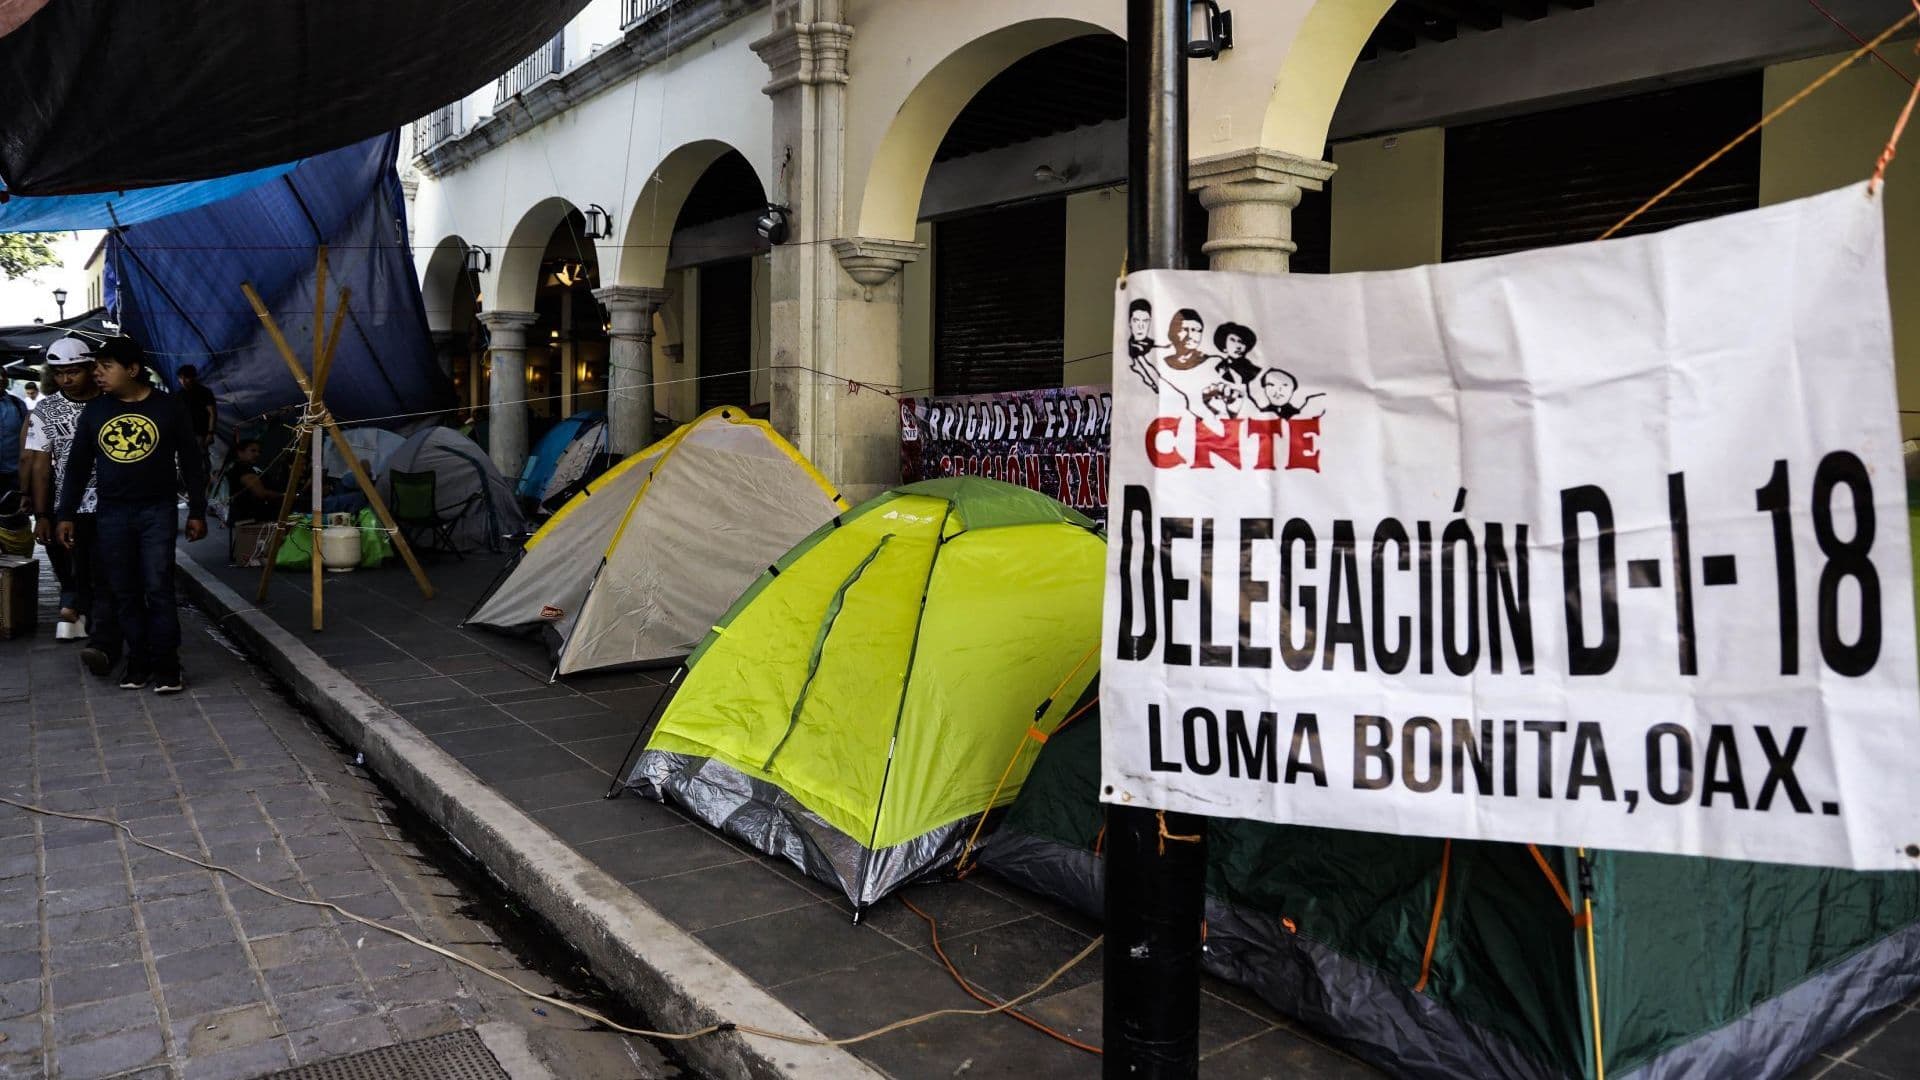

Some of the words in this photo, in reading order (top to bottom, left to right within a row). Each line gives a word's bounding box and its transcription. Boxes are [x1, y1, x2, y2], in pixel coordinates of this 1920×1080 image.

[928, 402, 1034, 441] BRIGADEO
[1145, 415, 1321, 473] CNTE
[1116, 484, 1535, 677] DELEGACIÓN
[1560, 450, 1882, 678] D-I-18
[1148, 703, 1328, 787] LOMA
